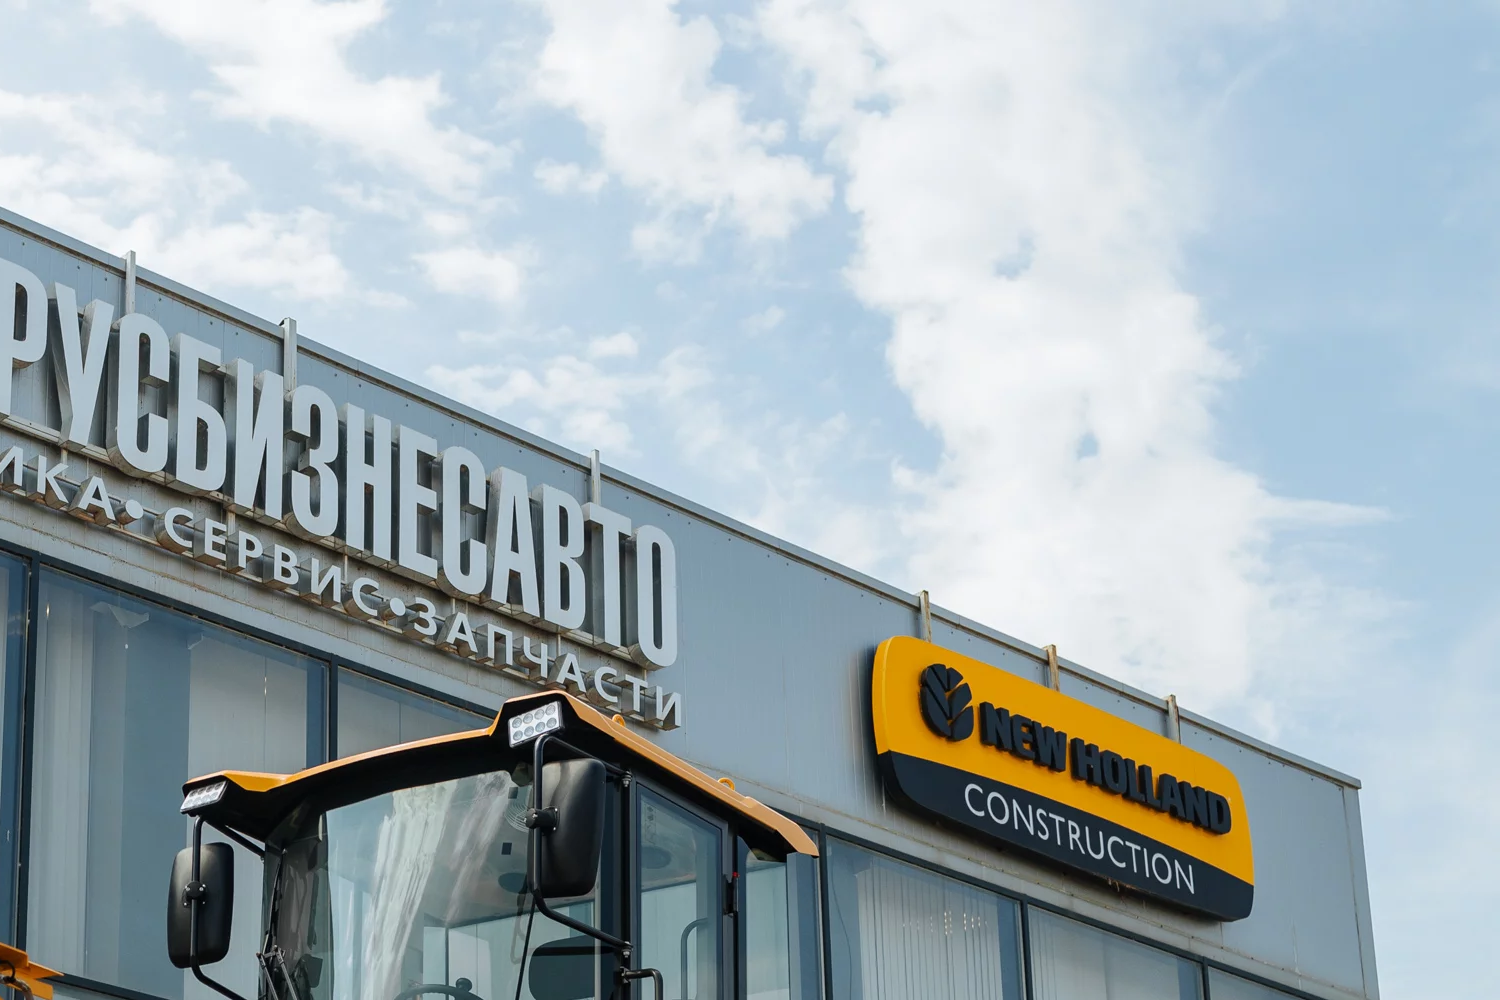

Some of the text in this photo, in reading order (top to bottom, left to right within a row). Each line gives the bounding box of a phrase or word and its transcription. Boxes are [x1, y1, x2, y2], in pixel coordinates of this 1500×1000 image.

[155, 506, 384, 620] СЕРВИС
[404, 597, 681, 730] ЗАПЧАСТИ
[979, 701, 1232, 835] NEW HOLLAND
[964, 783, 1196, 894] CONSTRUCTION
